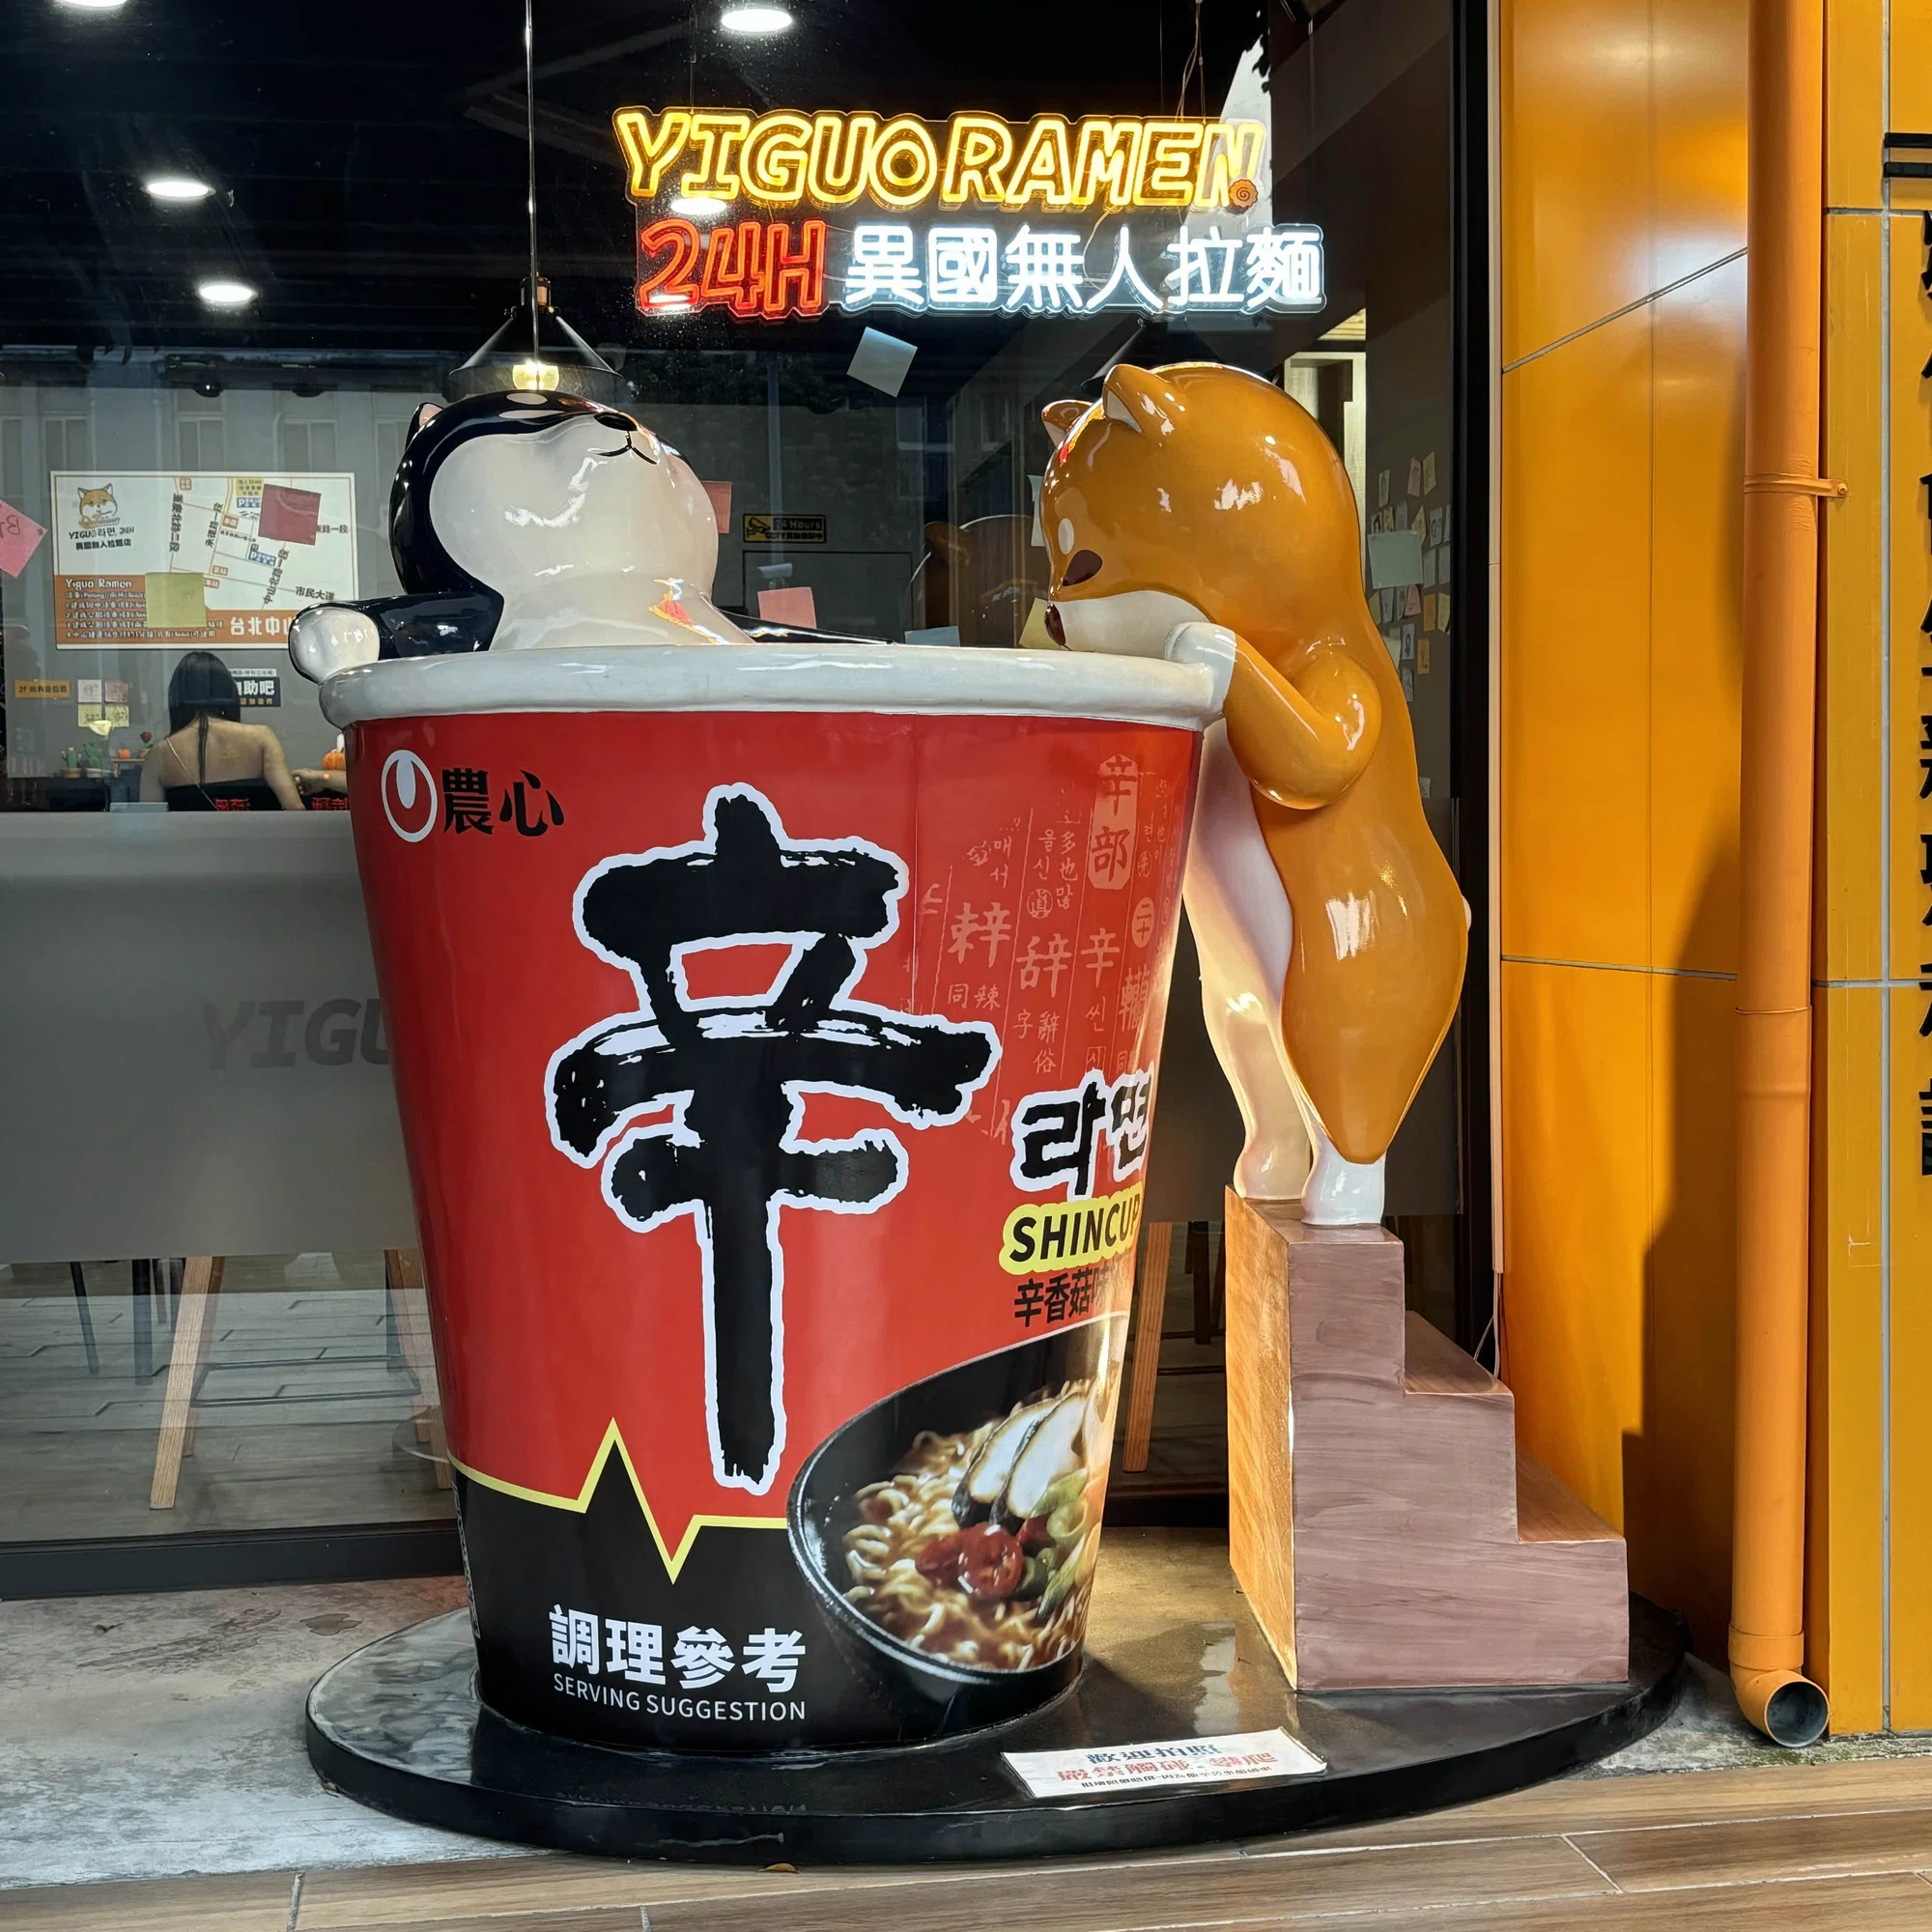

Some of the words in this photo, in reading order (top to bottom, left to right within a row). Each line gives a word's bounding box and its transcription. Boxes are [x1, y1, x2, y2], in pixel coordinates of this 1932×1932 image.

[614, 109, 938, 207] YIGUO
[944, 115, 1265, 210] RAMEN
[639, 218, 829, 314] 24H
[844, 222, 1325, 310] 異國無人拉麵
[66, 578, 94, 591] Yiguo
[99, 578, 131, 589] Ramen
[295, 585, 335, 601] 市民大道
[441, 767, 565, 838] 農心
[550, 788, 999, 1492] 辛
[1009, 1199, 1142, 1264] SHINCUP
[548, 1604, 807, 1693] 調理參考
[553, 1672, 640, 1712] SERVING
[645, 1693, 806, 1721] SUGGESTION
